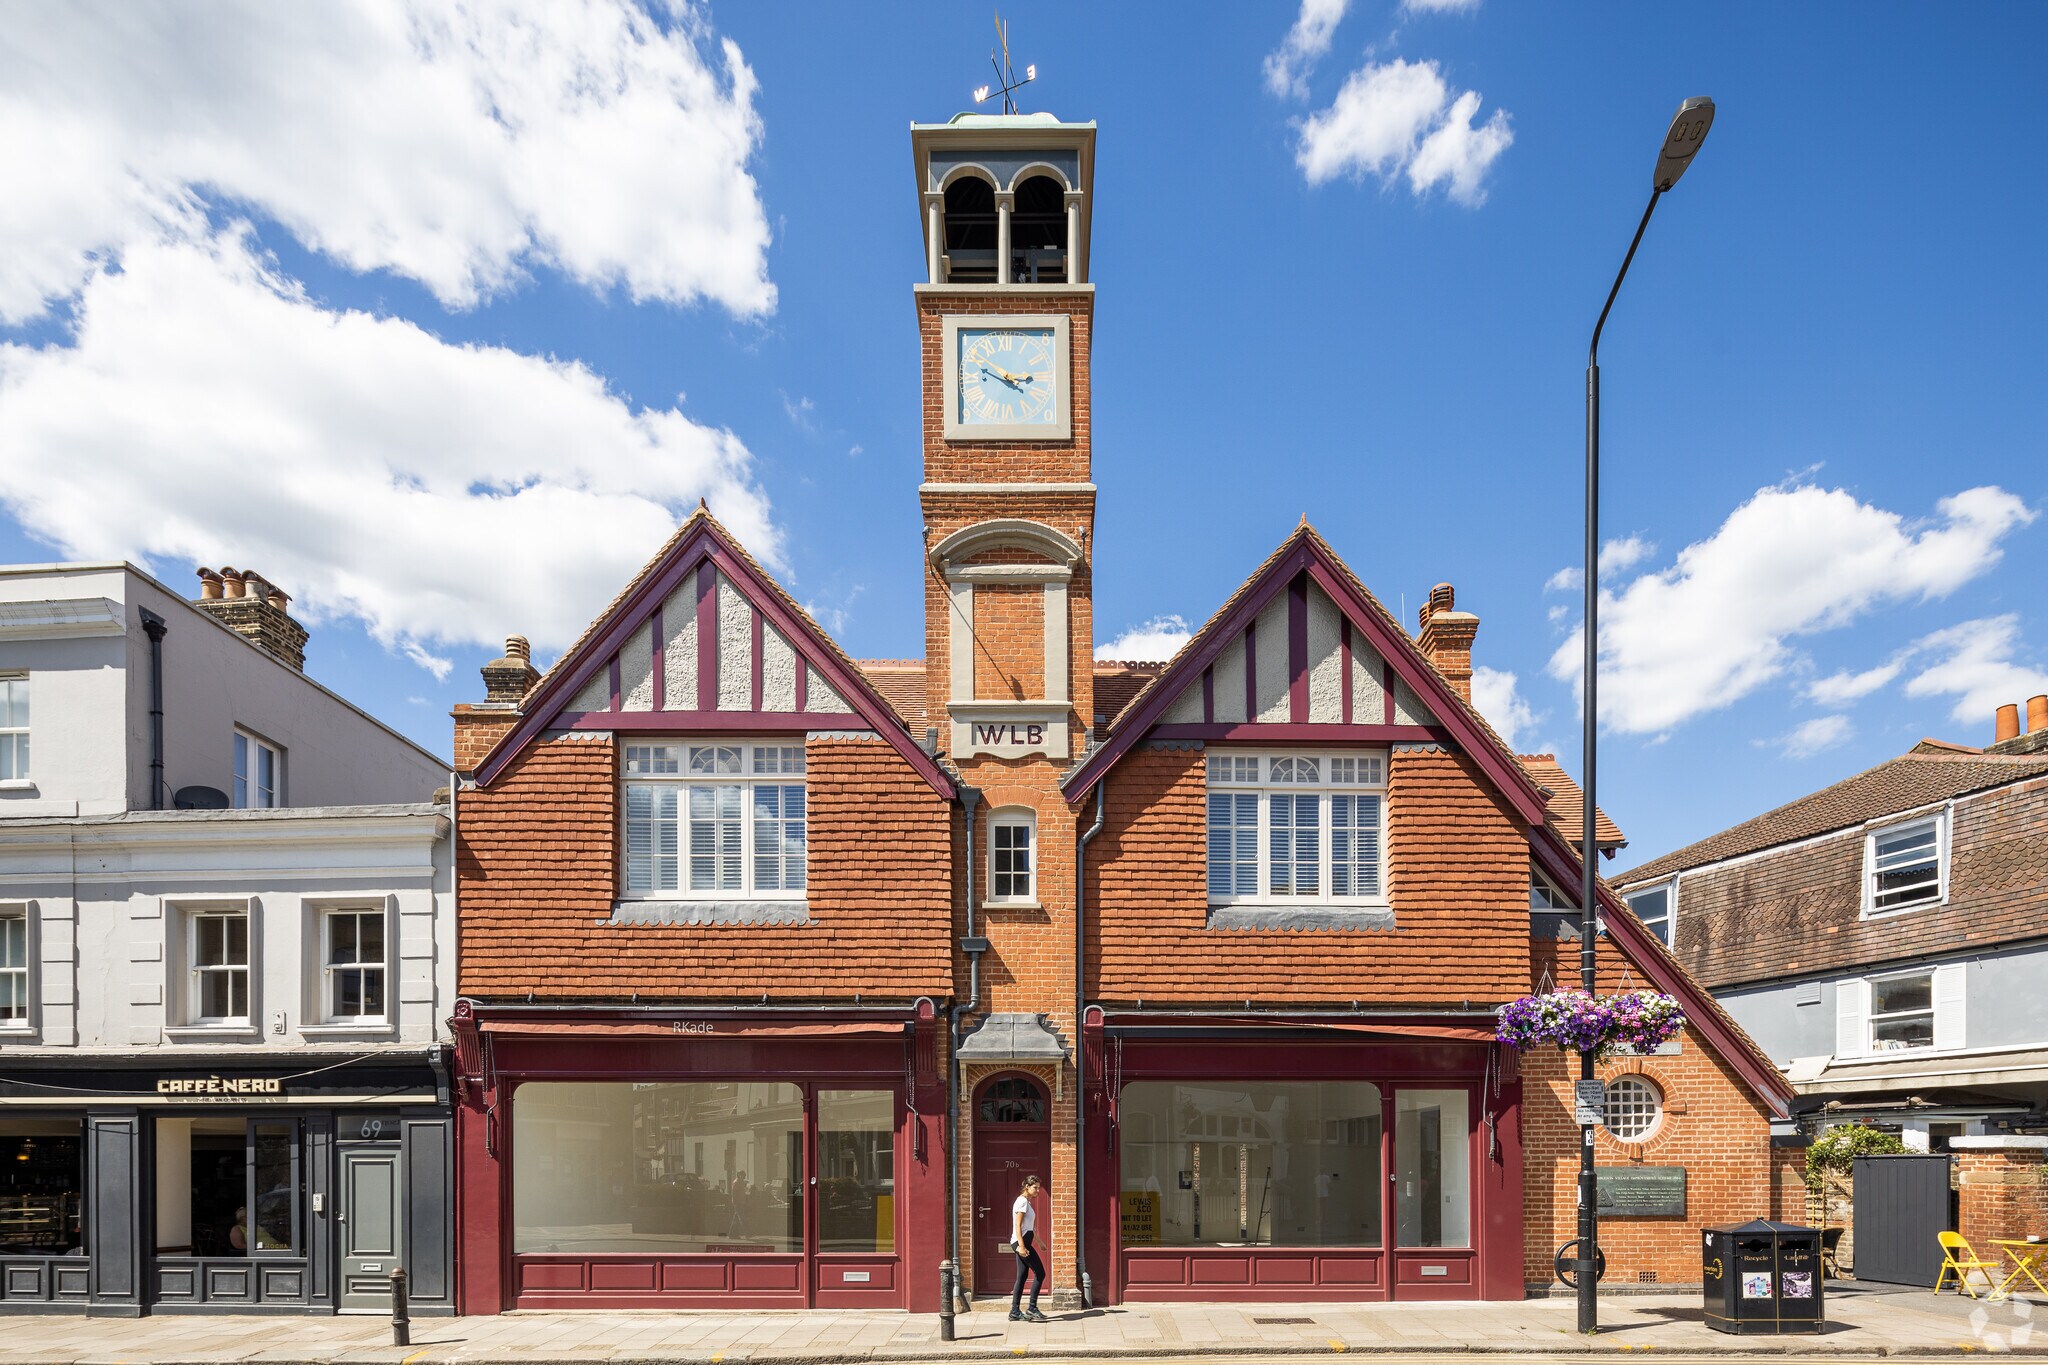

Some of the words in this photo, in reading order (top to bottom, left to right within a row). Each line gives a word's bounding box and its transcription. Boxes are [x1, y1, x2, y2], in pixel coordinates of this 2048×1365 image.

[974, 85, 989, 103] W
[980, 337, 996, 357] XI
[997, 335, 1013, 352] XII
[1028, 354, 1045, 366] II
[1032, 371, 1050, 383] III
[977, 725, 1044, 745] WLB
[673, 1021, 714, 1034] RKade
[157, 1074, 220, 1093] CAFFÈ
[222, 1079, 280, 1093] NERO
[361, 1120, 381, 1138] 69
[1129, 1197, 1152, 1206] LEWIS
[1136, 1205, 1152, 1213] &CO
